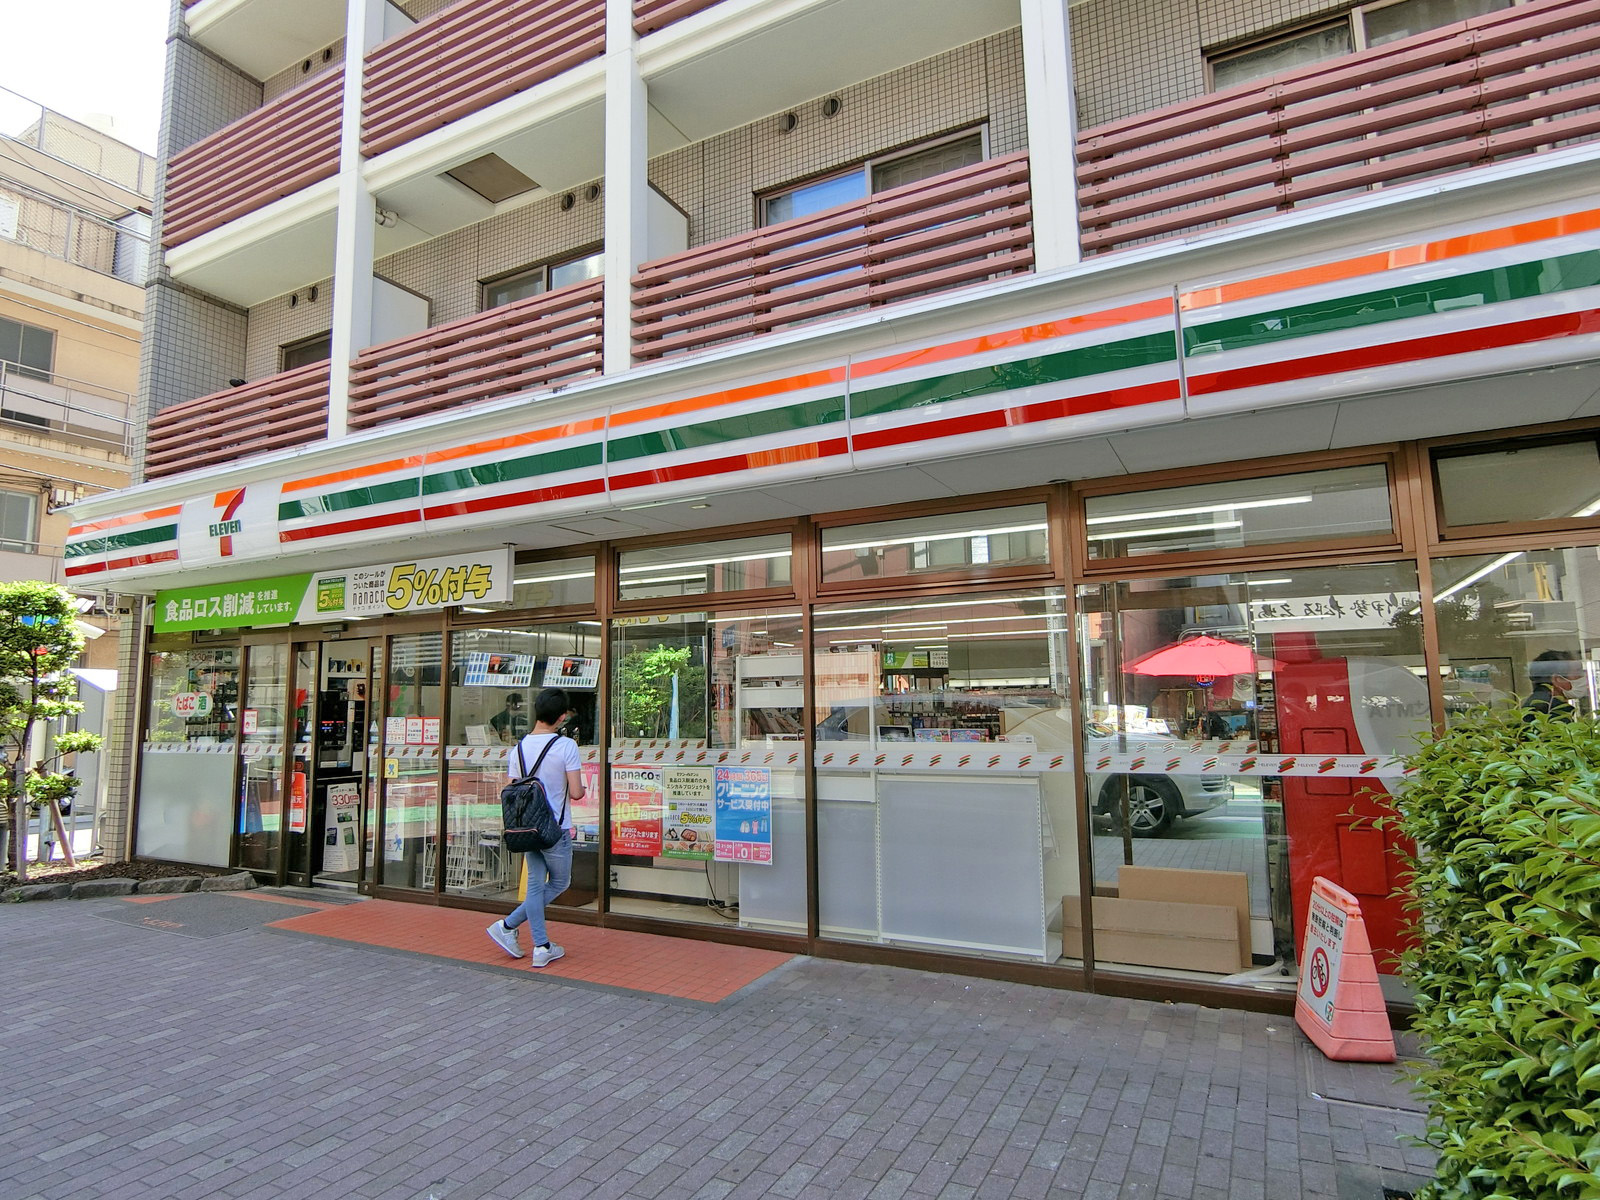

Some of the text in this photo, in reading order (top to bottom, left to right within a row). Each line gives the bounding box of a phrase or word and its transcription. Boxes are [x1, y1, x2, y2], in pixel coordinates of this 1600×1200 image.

[353, 570, 386, 581] このシールが
[353, 580, 385, 590] ついた商品は
[386, 563, 492, 610] 5%付与
[257, 589, 278, 601] を推進
[352, 590, 385, 606] nanaco
[165, 592, 255, 622] 食品ロス削減
[256, 601, 293, 614] しています。
[175, 695, 207, 711] たばこ 酒
[717, 782, 769, 799] クリーニング
